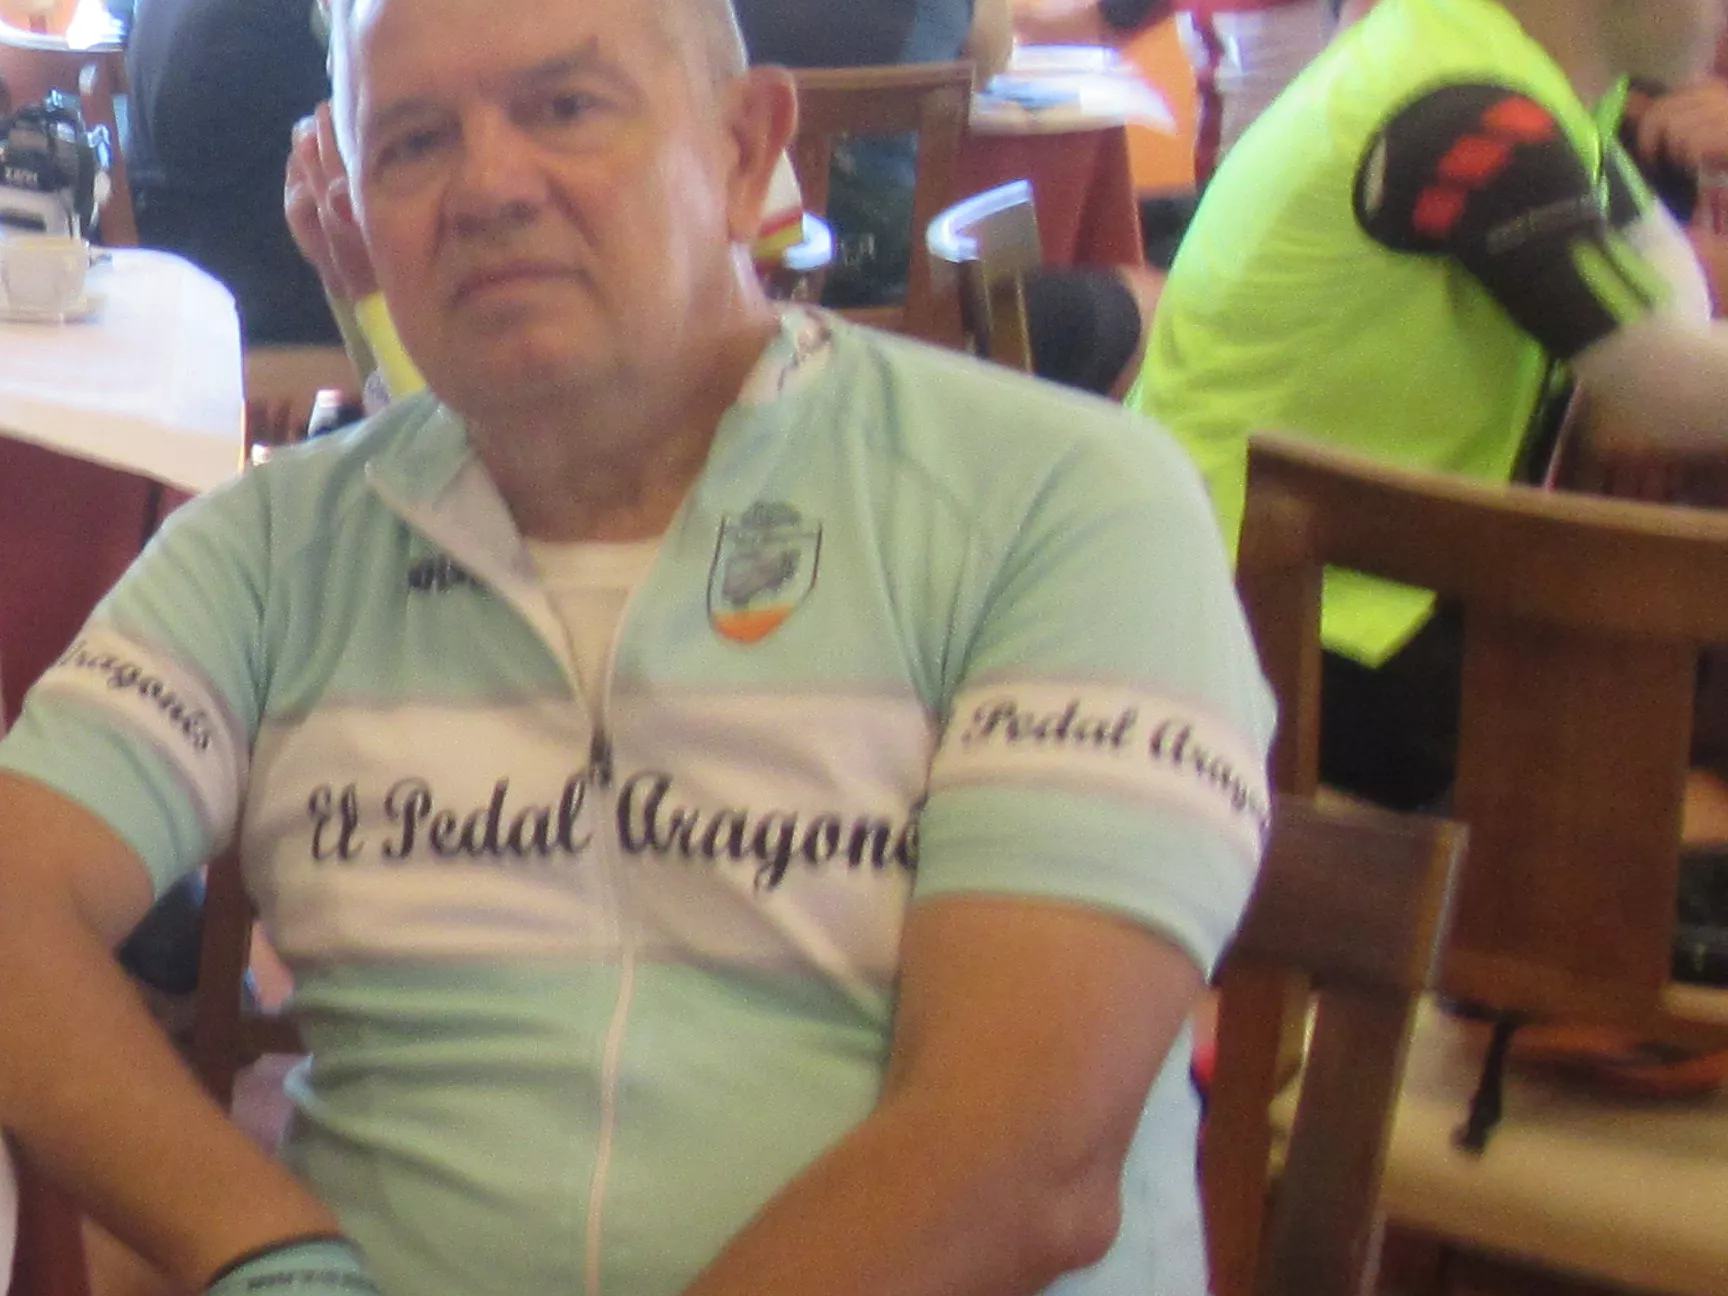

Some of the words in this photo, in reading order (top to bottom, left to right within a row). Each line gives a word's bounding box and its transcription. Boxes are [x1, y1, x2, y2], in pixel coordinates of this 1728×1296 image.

[307, 783, 365, 862] El
[382, 769, 592, 861] Pedal
[614, 771, 921, 892] Aragoné
